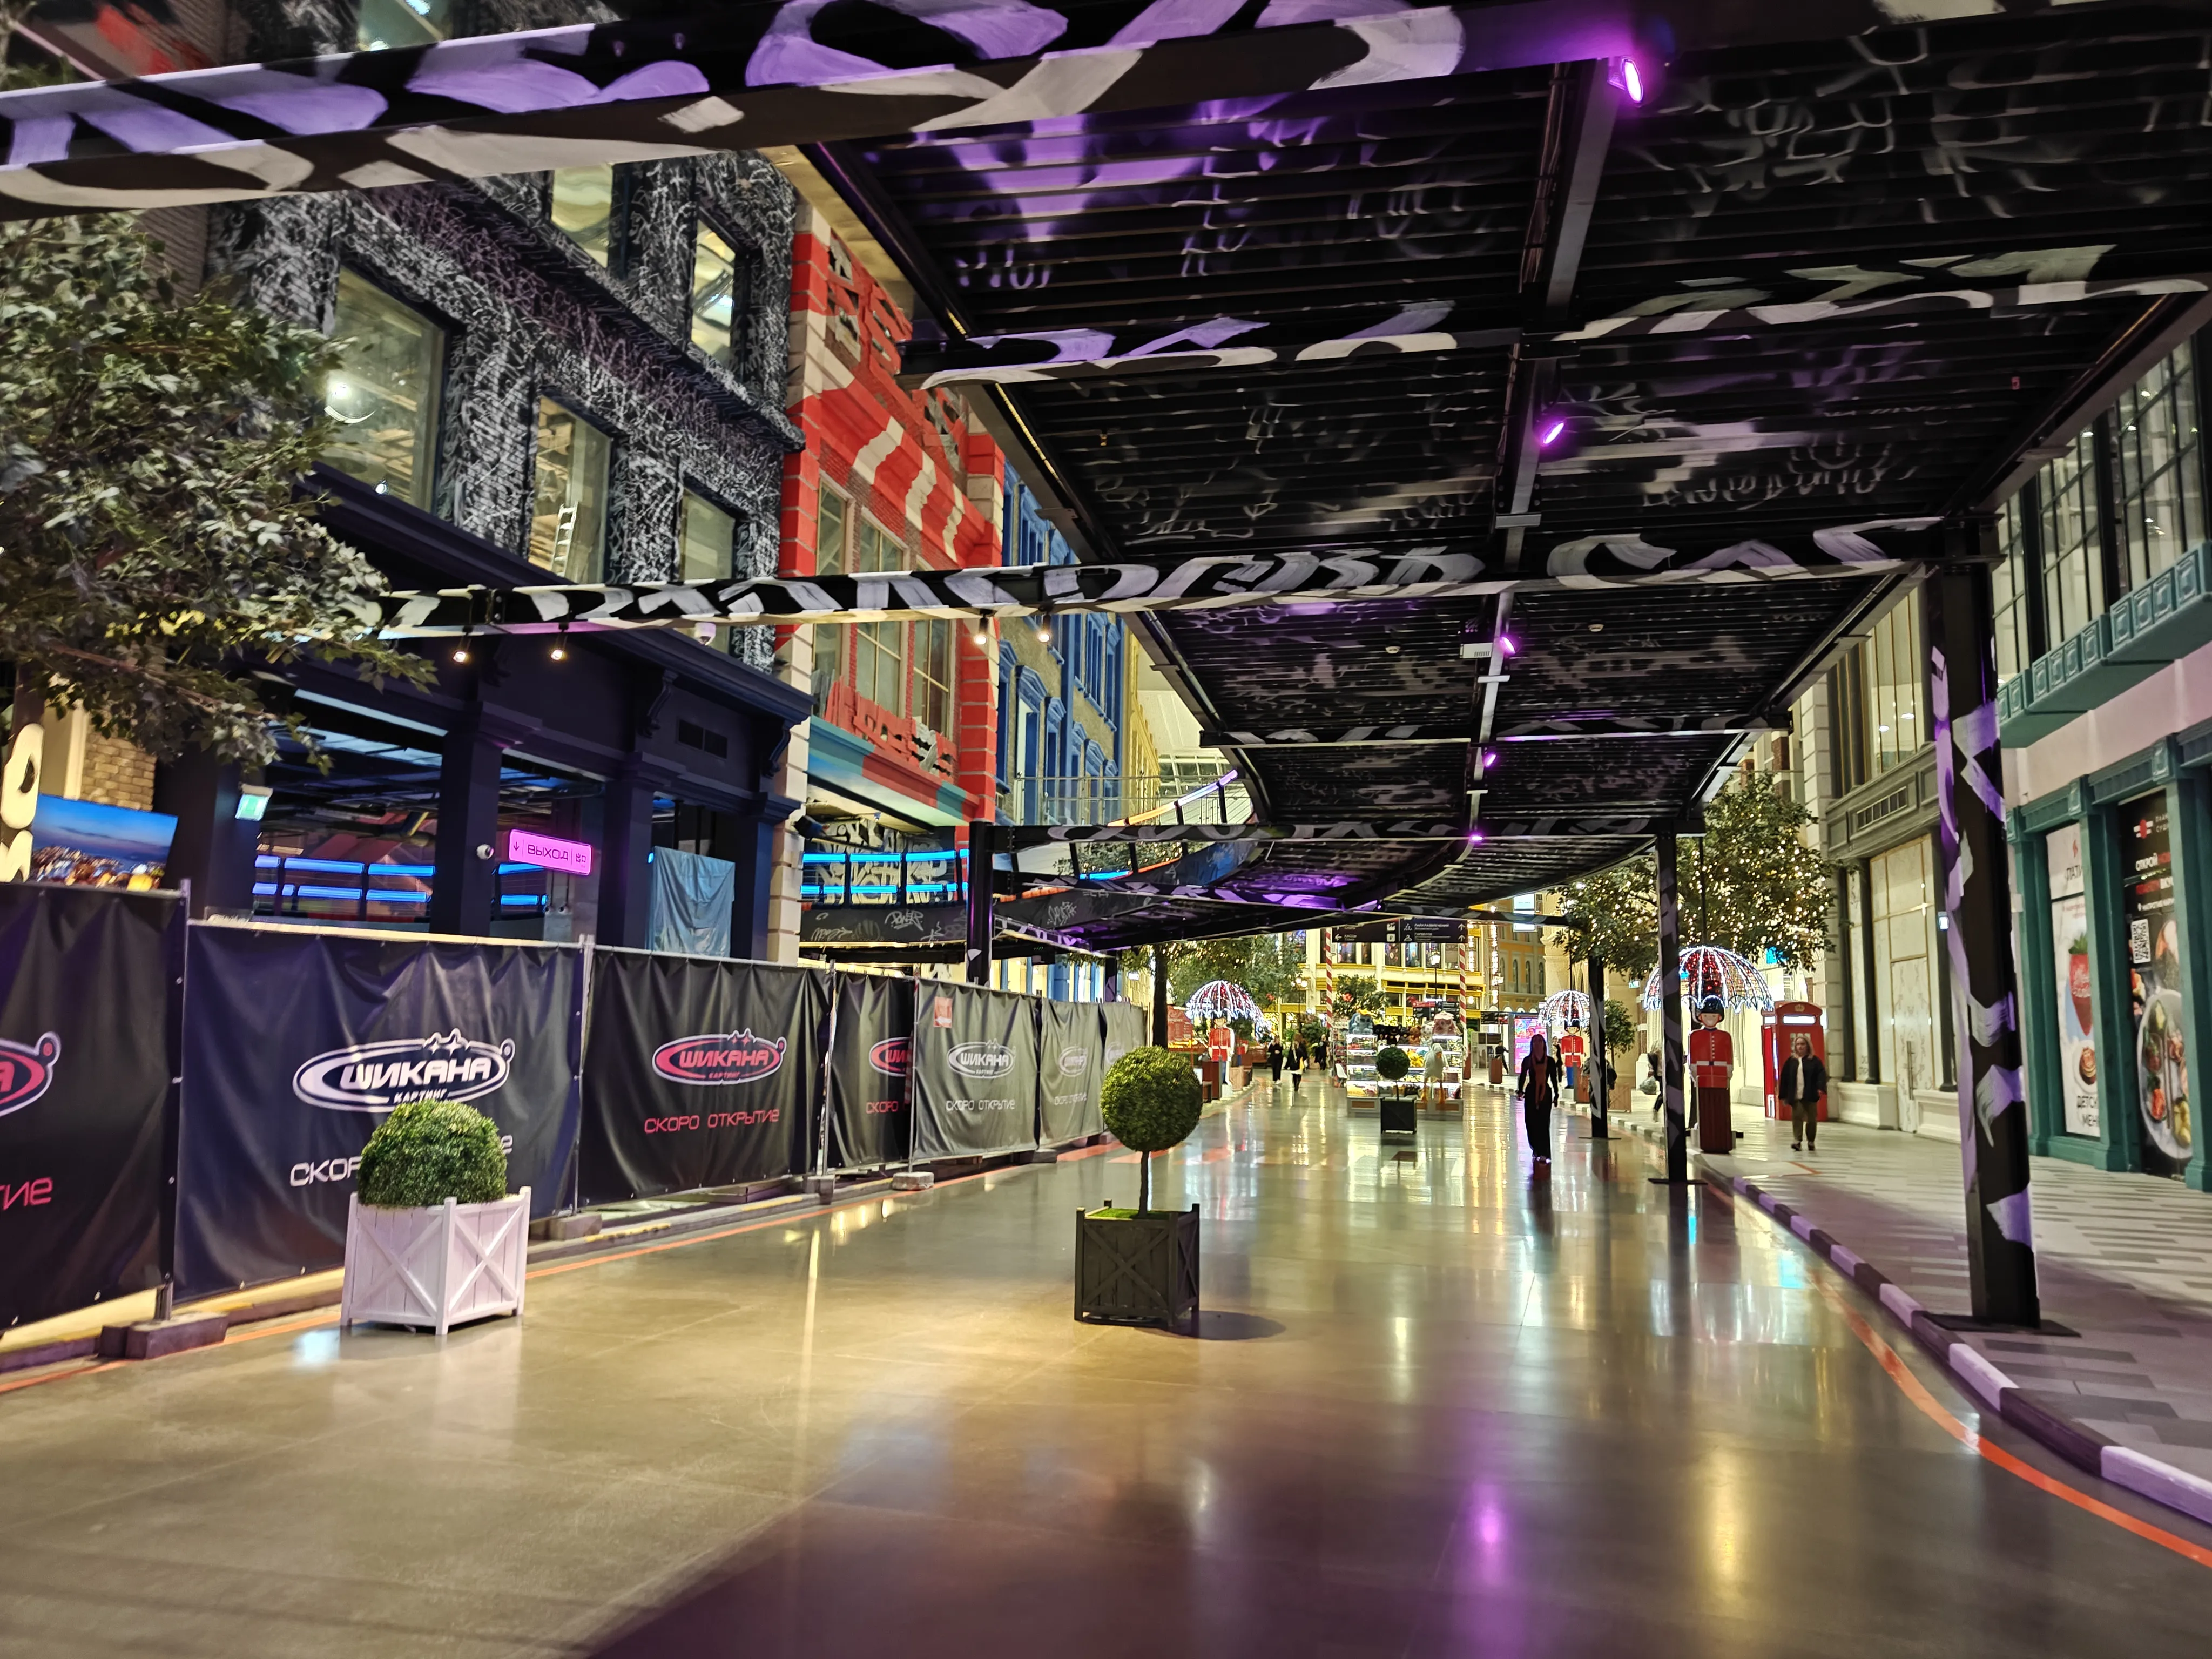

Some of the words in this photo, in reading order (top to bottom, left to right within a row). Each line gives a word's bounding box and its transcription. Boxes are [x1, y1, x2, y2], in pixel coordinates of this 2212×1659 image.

[528, 844, 569, 861] ВЫХОД
[575, 853, 586, 863] 出口
[679, 1050, 770, 1068] ШИКАНА
[960, 1053, 1009, 1067] ШИКАНА
[339, 1057, 492, 1090] ШИКАНА
[866, 1100, 899, 1114] СКОРО
[946, 1100, 975, 1111] СКОРО
[978, 1098, 1016, 1111] ОТКРЫТИЕ
[644, 1114, 700, 1134] СКОРО
[707, 1109, 780, 1128] ОТКРЫТИЕ
[290, 1156, 362, 1187] СКОР
